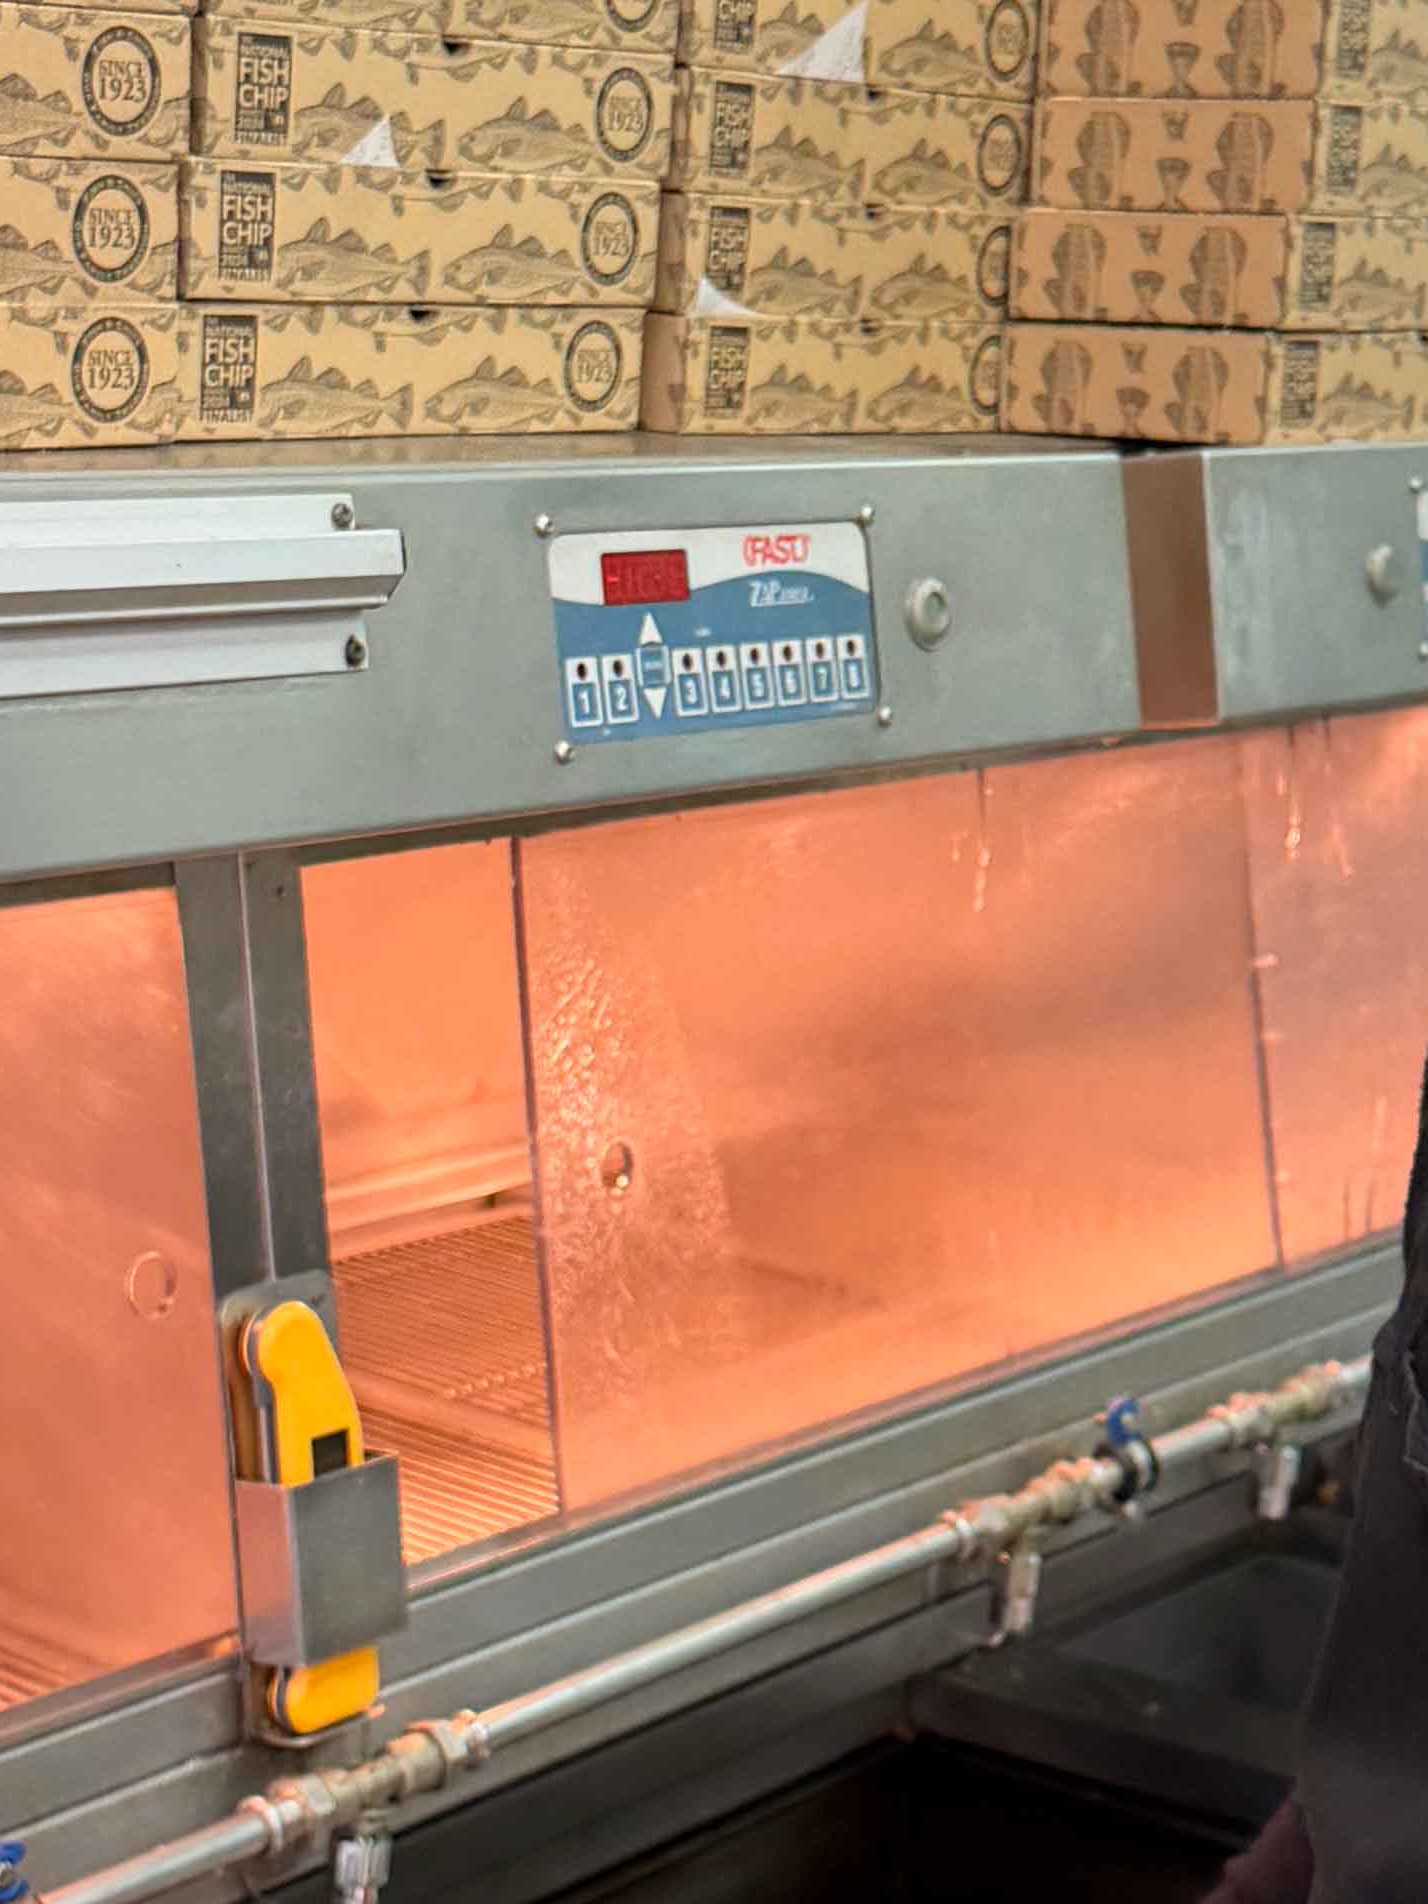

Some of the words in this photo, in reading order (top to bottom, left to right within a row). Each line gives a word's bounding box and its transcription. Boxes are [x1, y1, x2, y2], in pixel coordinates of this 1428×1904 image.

[240, 57, 289, 85] FISH
[238, 84, 288, 108] CHIP
[88, 209, 136, 225] SINCE
[223, 195, 273, 221] FISH
[89, 227, 135, 249] 1923
[222, 222, 271, 245] CHIP
[205, 338, 255, 363] FISH
[204, 364, 253, 388] CHIP
[579, 691, 589, 714] 1
[616, 685, 628, 711] 2
